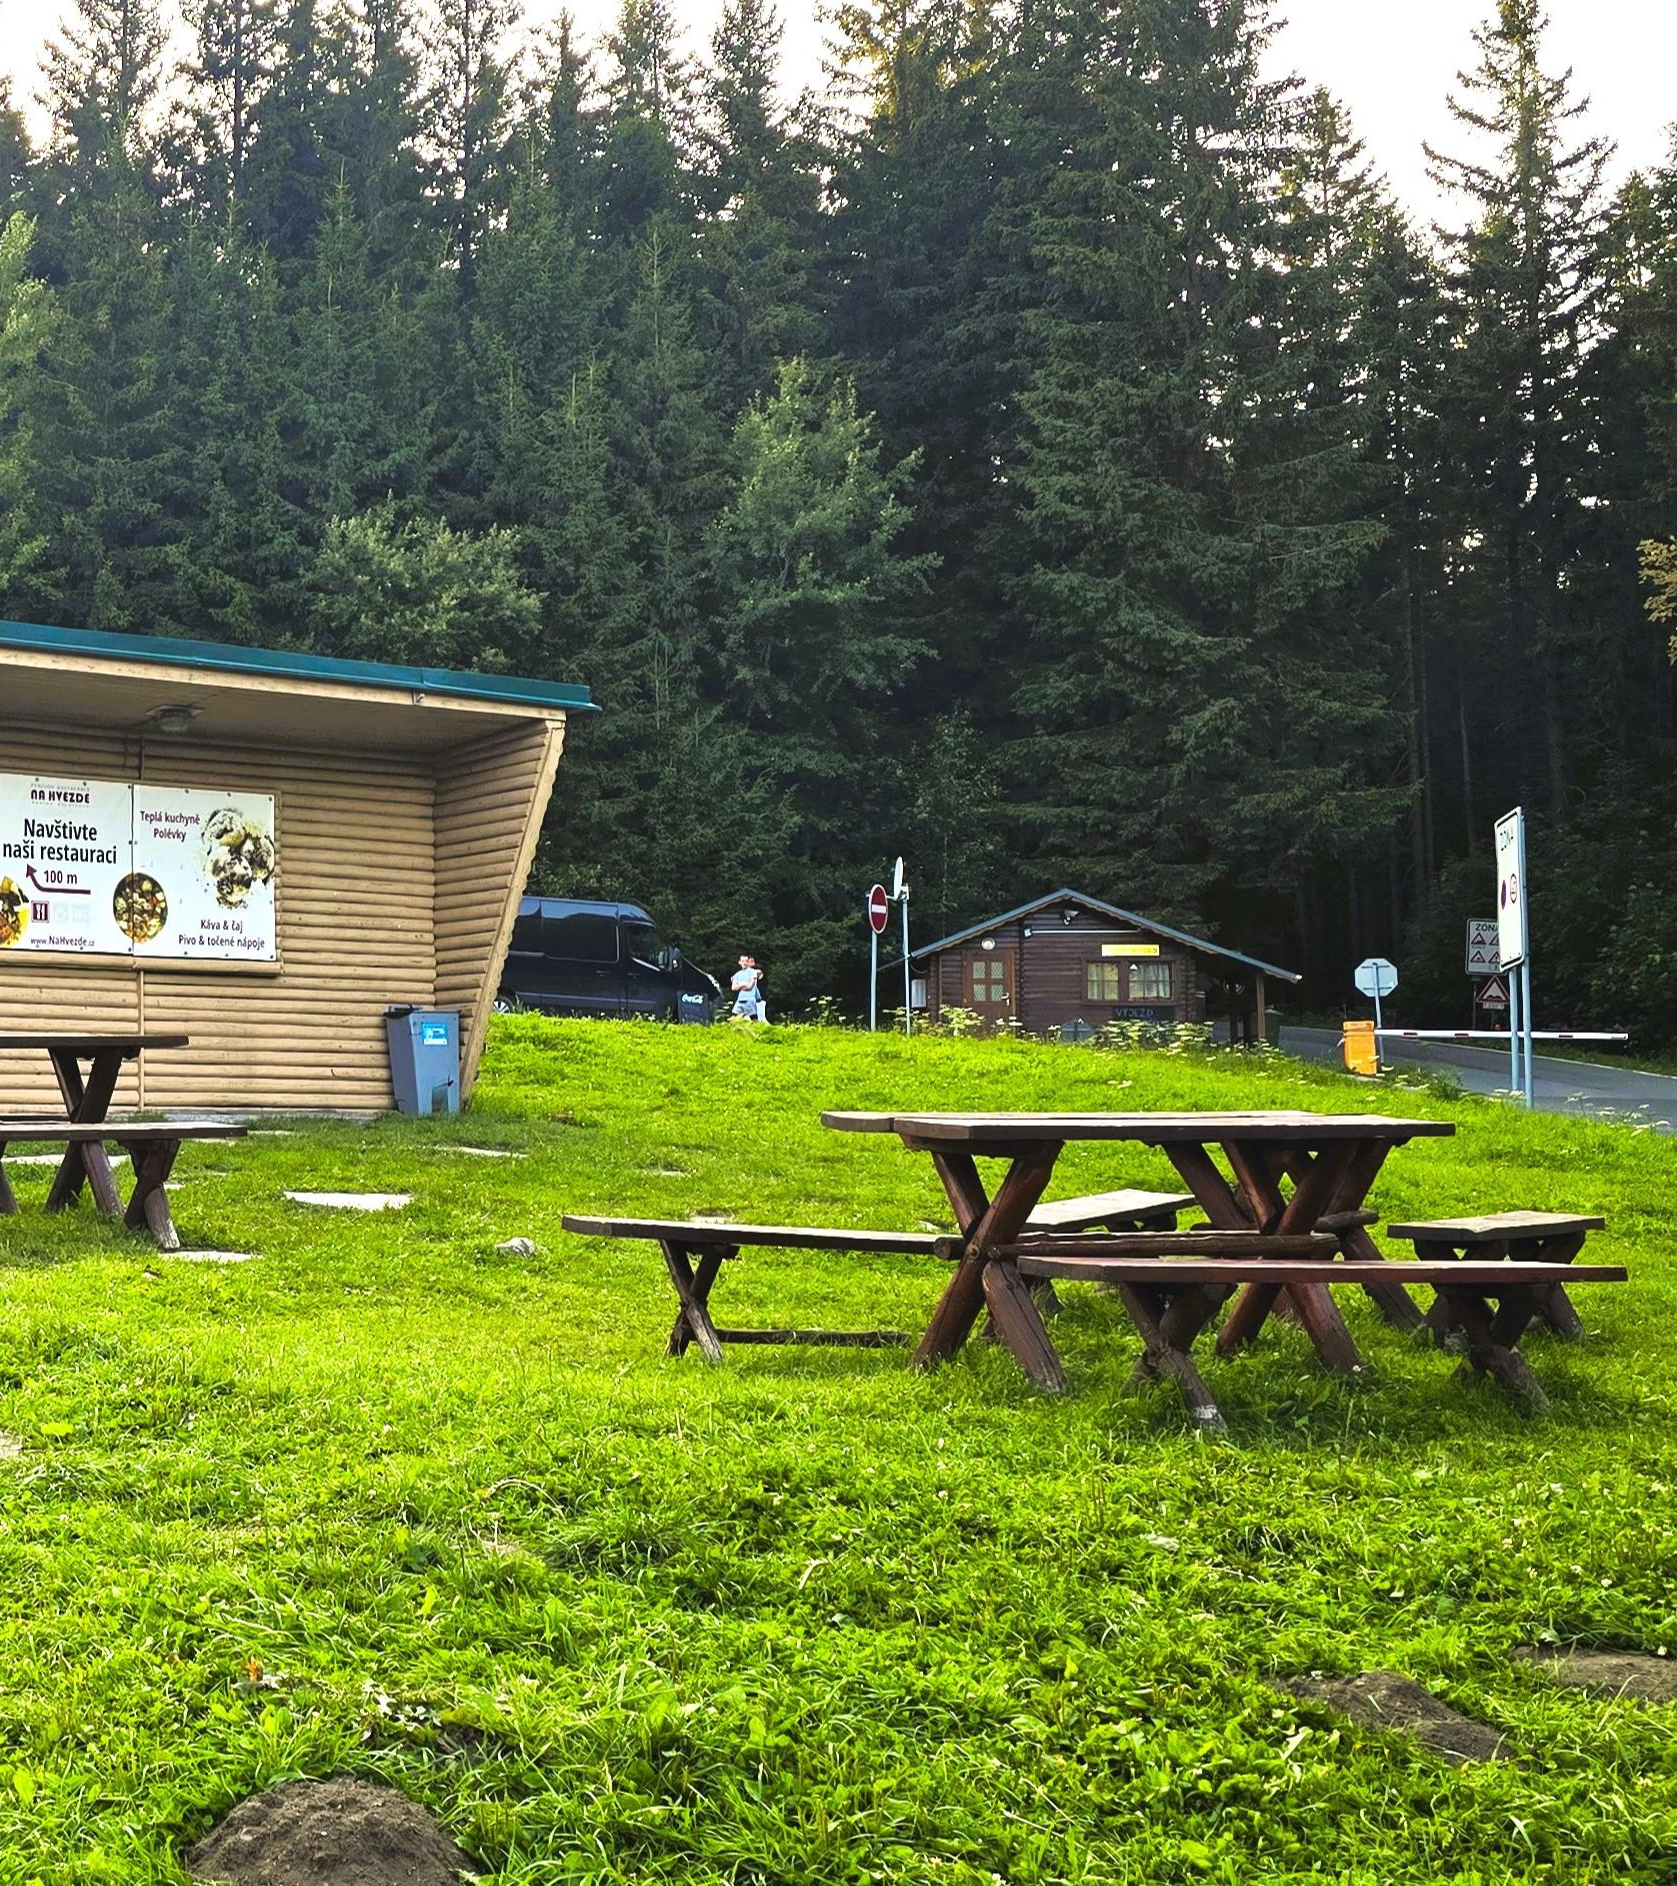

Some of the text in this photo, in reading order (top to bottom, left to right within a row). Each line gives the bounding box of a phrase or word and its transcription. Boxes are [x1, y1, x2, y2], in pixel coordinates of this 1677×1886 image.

[31, 789, 90, 804] NA HVEZDE
[140, 810, 201, 827] Teplá kuchyně
[24, 818, 98, 841] Navštivte
[153, 827, 187, 843] Polévky
[3, 839, 117, 864] naši restauraci
[43, 870, 78, 884] 100 m
[200, 919, 243, 934] Káva & čaj
[178, 933, 265, 951] Pivo & točené nápoje
